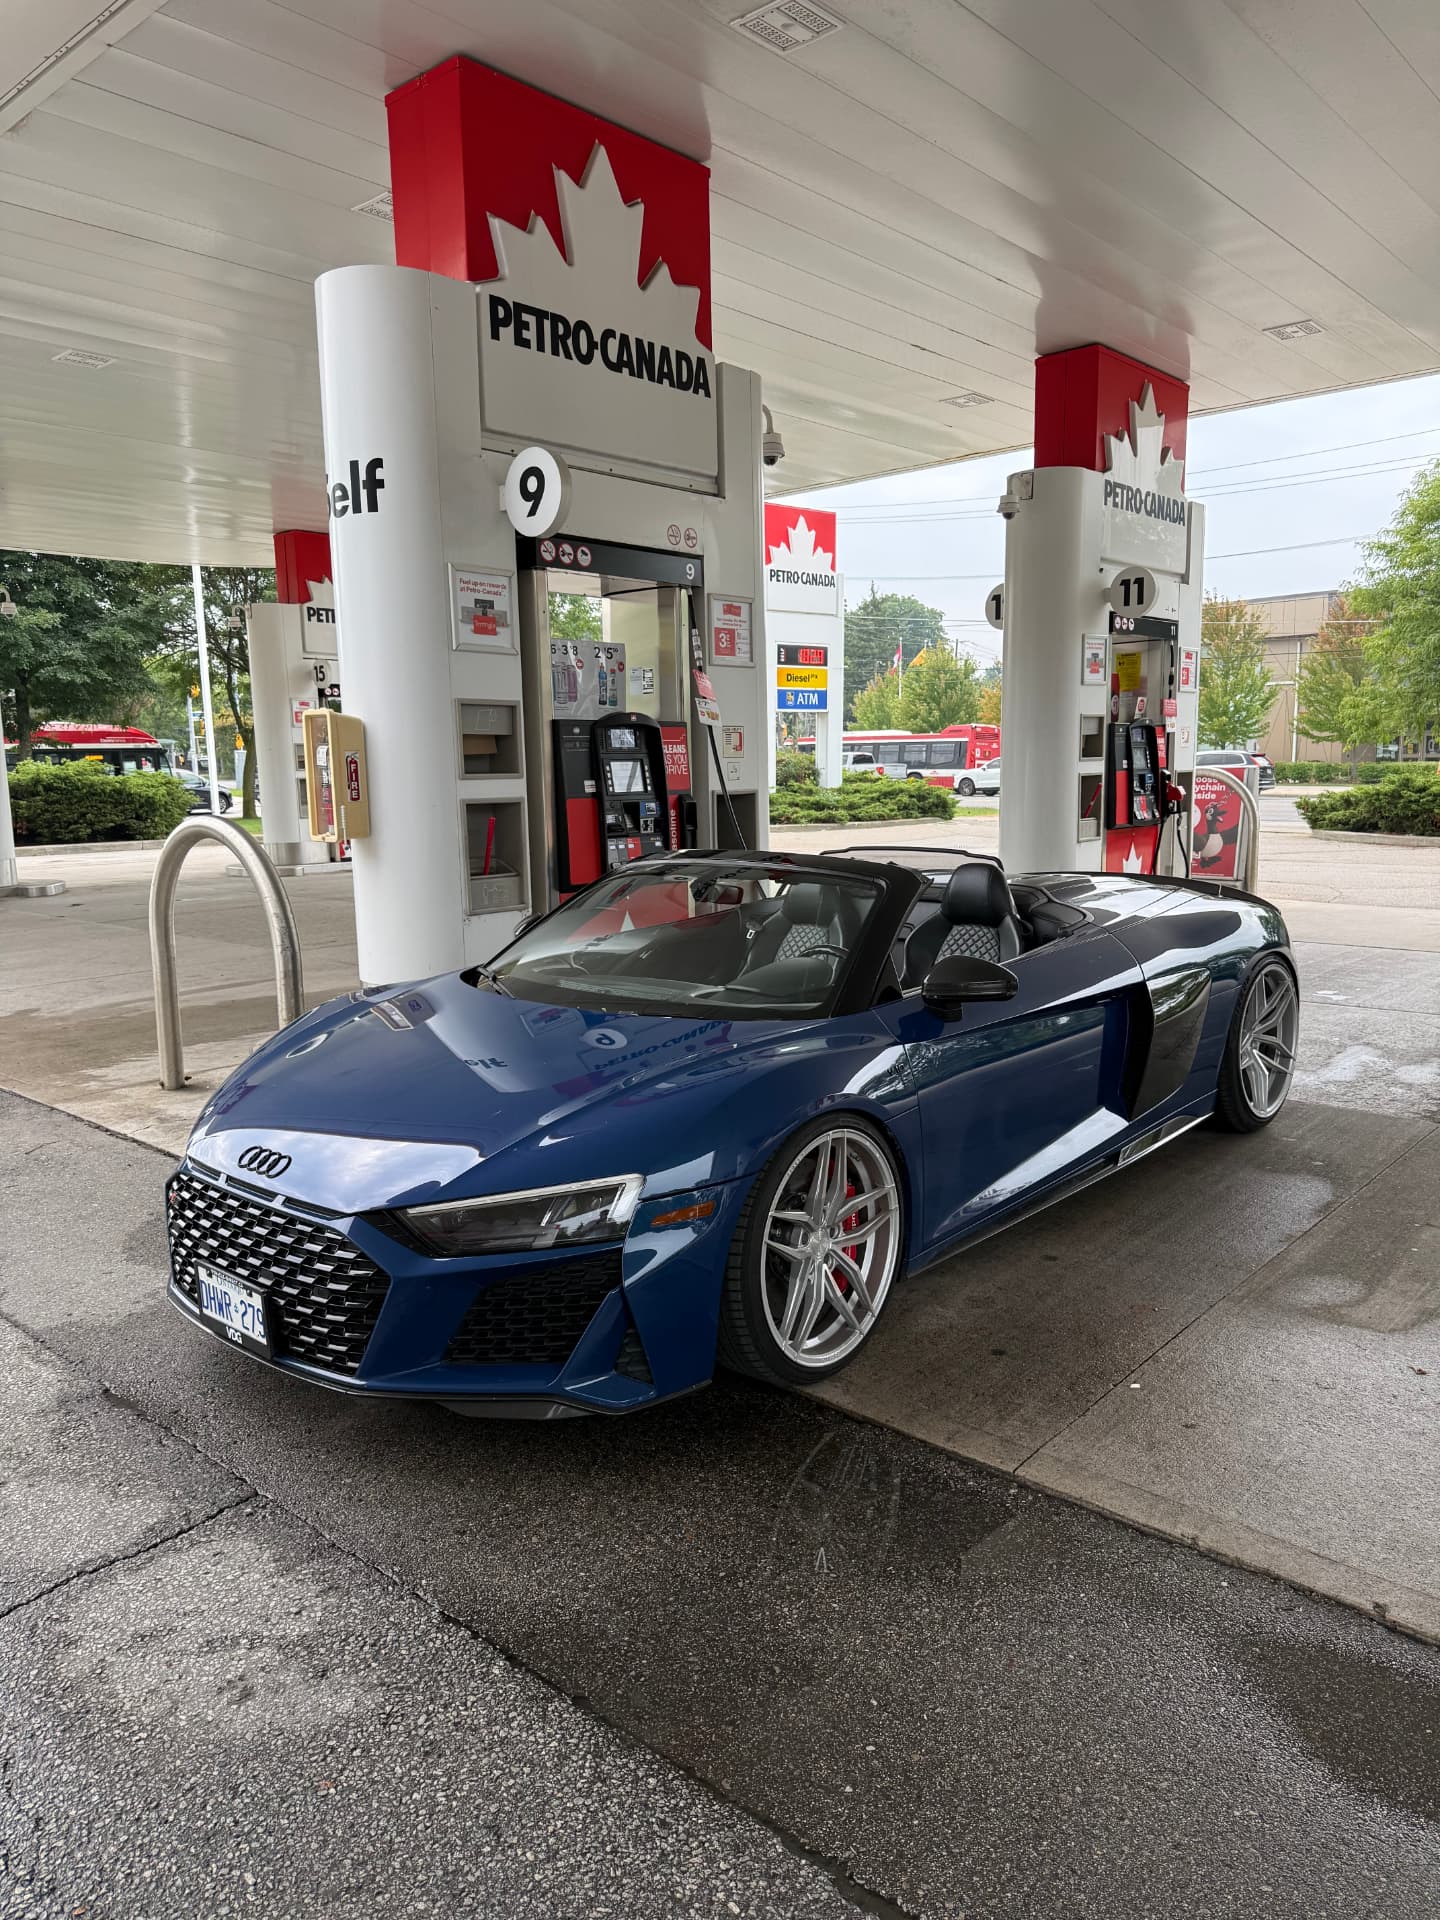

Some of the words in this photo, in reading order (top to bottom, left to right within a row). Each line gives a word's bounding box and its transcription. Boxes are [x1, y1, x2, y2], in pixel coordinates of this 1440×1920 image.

[489, 294, 711, 398] PETRO-CANADA
[326, 457, 385, 518] elf
[519, 466, 545, 518] 9
[1104, 479, 1186, 526] PETRO-CANADA
[685, 563, 695, 580] 9
[769, 568, 836, 588] PETRO-CANADA
[1119, 577, 1145, 607] 11
[314, 665, 326, 682] 15
[786, 673, 810, 683] Diesel
[797, 692, 819, 705] ATM
[351, 763, 359, 799] FIRE
[199, 1279, 233, 1323] DHWR
[226, 1326, 243, 1345] VDG
